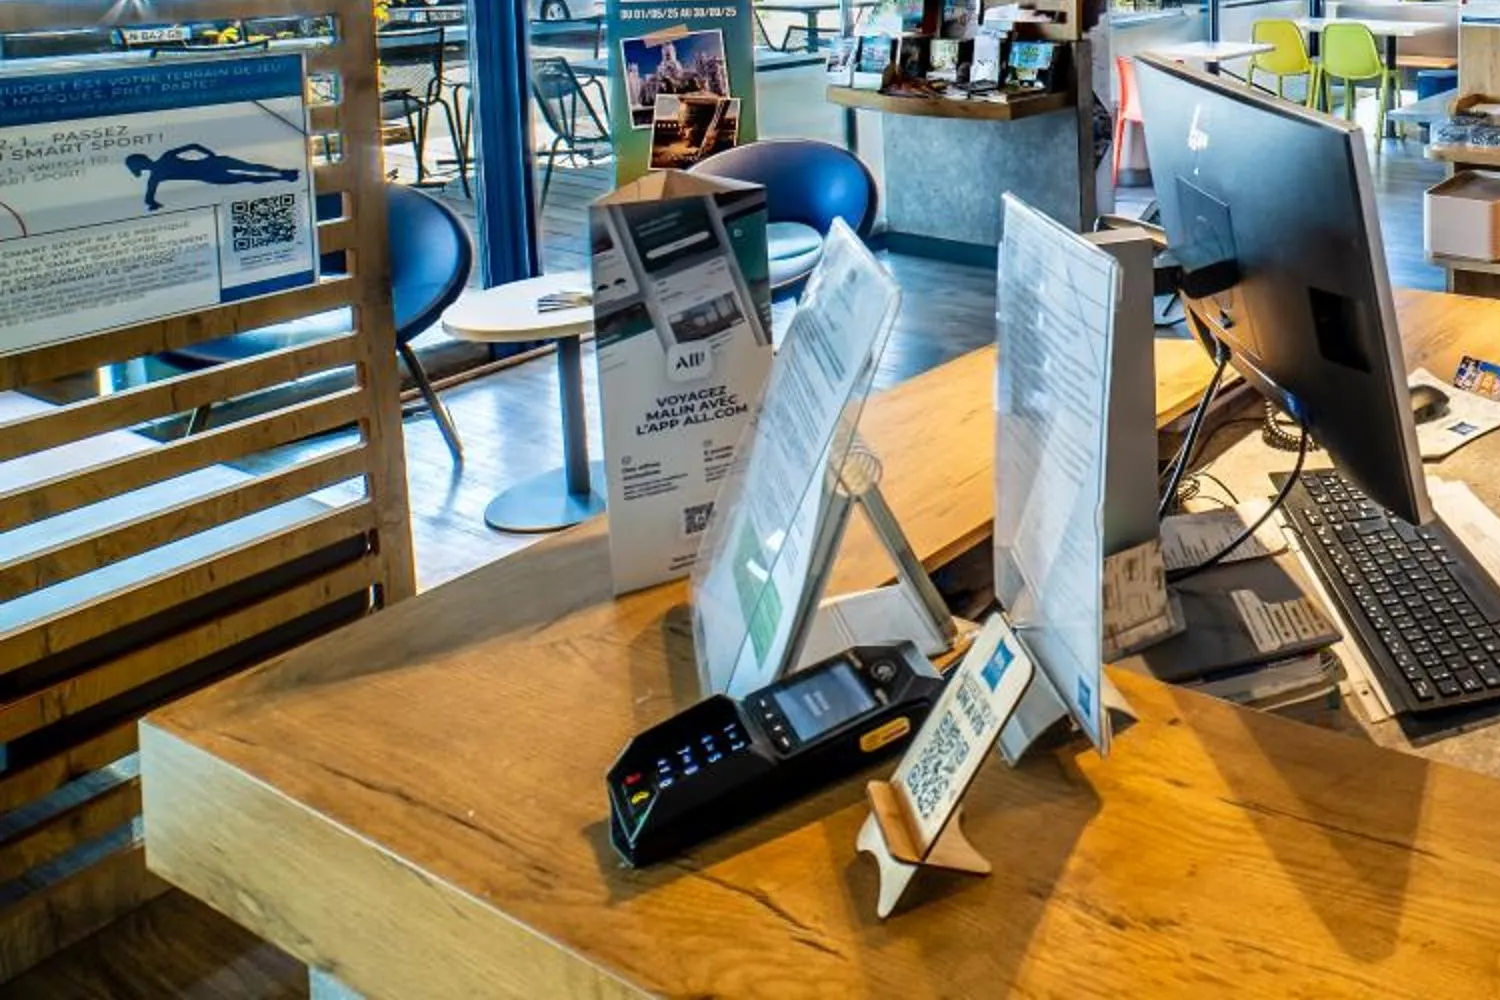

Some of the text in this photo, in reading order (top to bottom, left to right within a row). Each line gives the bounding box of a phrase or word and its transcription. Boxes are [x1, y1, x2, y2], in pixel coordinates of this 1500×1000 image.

[0, 80, 65, 96] UDGET
[52, 125, 129, 144] PASSEZ
[11, 142, 83, 161] SMART
[92, 134, 158, 151] SPORT
[645, 393, 739, 422] MALIN AVEC
[656, 385, 727, 408] VOYAGEZ
[636, 403, 749, 436] L'APP ALL.COM
